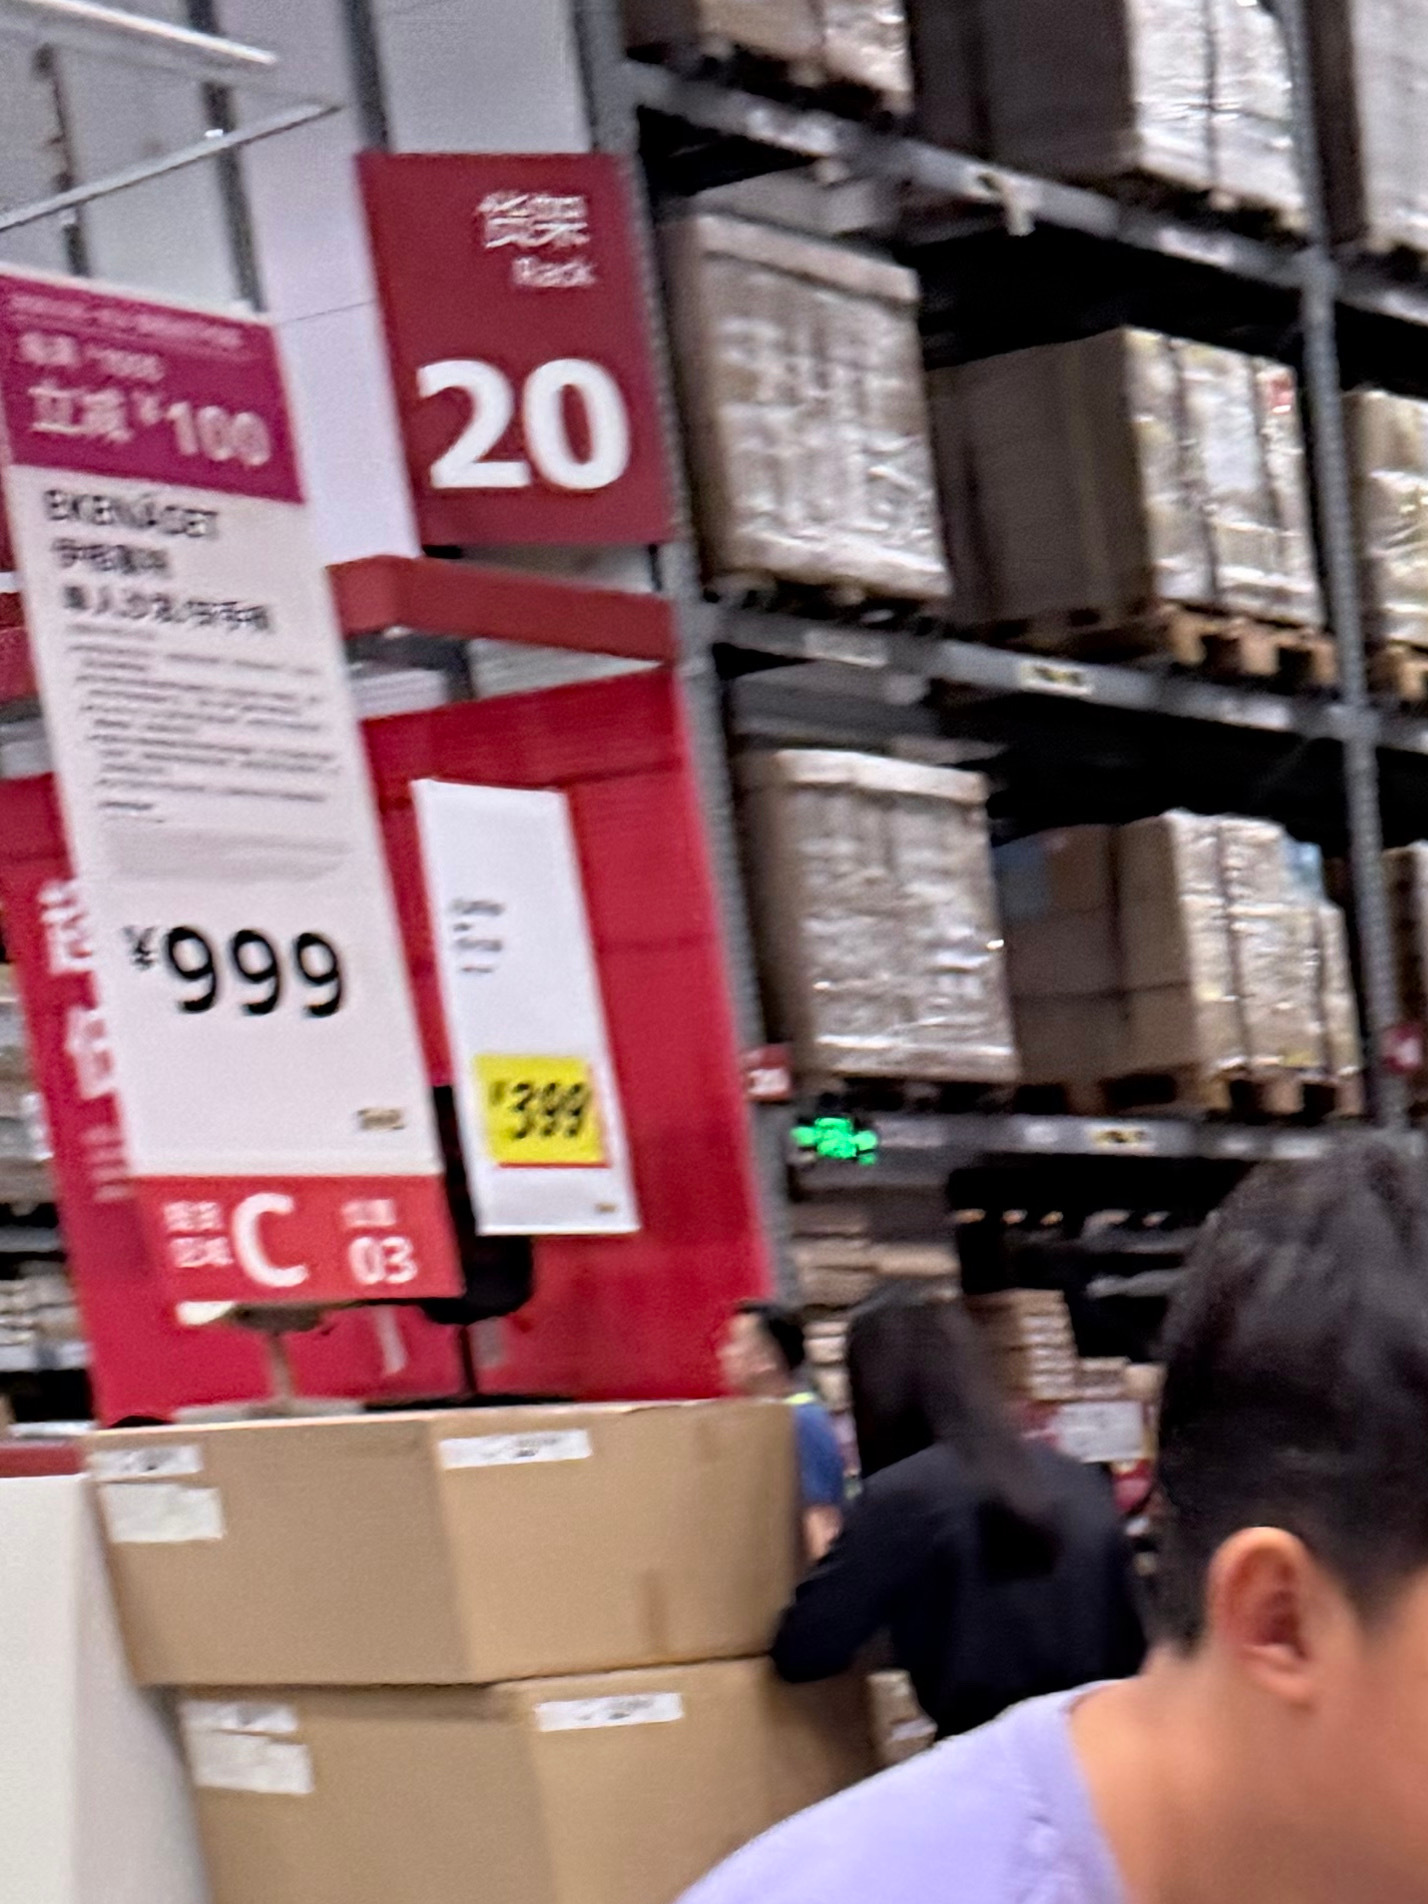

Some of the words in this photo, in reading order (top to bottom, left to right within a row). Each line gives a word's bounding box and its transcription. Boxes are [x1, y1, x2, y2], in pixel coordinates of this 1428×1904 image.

[416, 358, 632, 491] 20
[121, 924, 346, 1018] ¥999
[231, 1192, 309, 1288] C
[347, 1235, 419, 1286] 03
